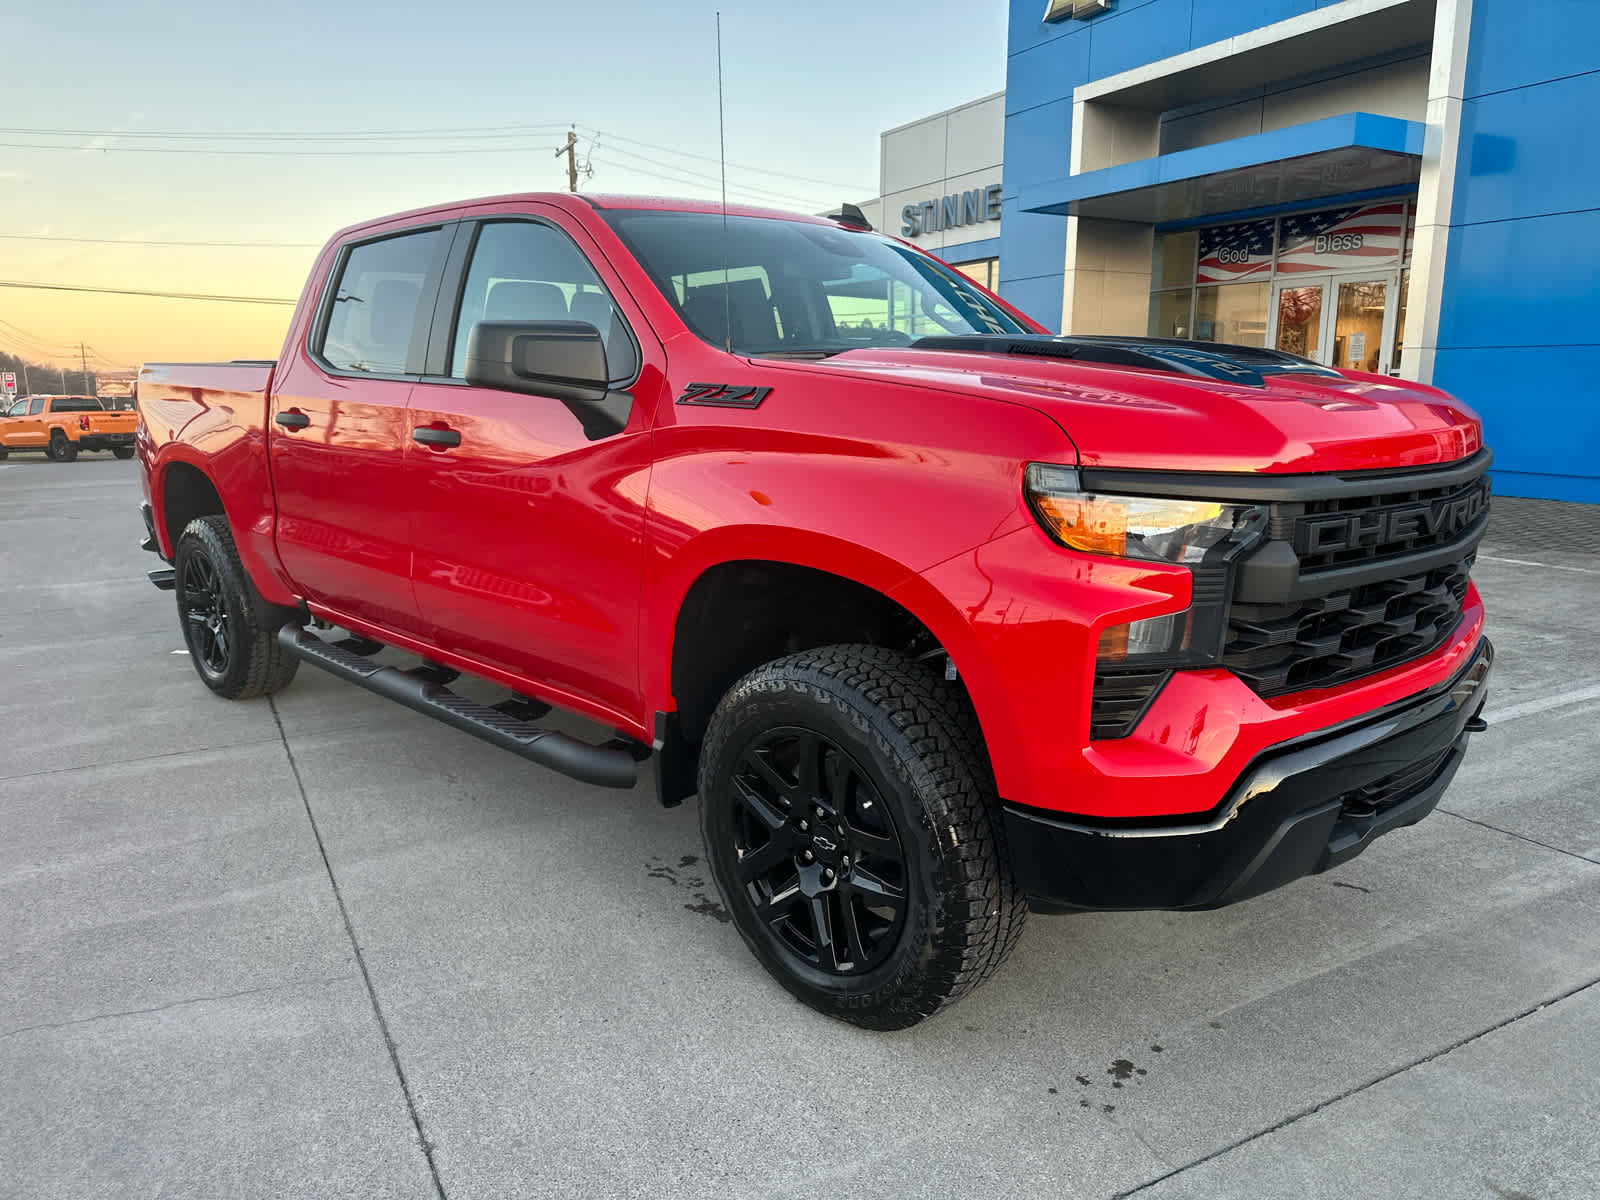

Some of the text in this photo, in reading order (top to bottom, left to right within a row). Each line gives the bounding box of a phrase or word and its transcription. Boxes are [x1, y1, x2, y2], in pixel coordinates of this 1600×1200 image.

[1217, 234, 1364, 264] God Bless
[675, 382, 775, 409] Z71
